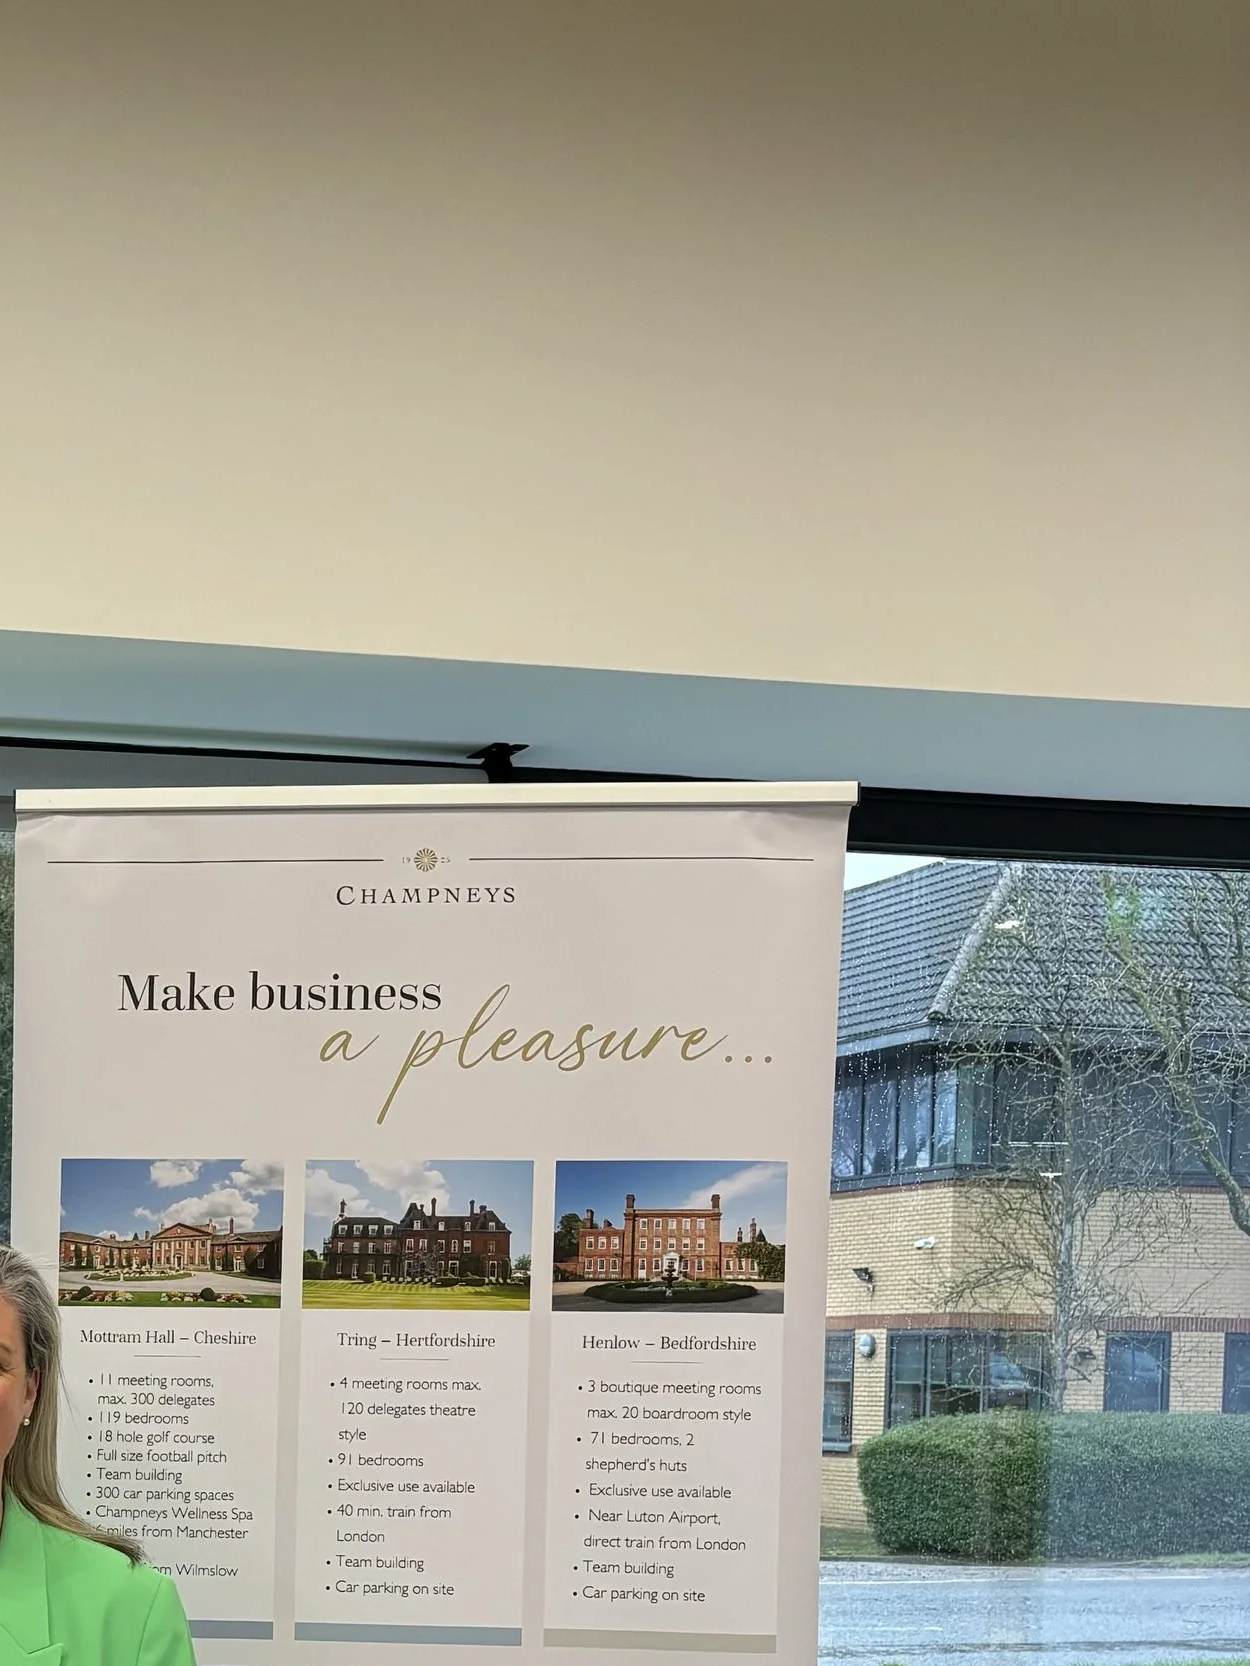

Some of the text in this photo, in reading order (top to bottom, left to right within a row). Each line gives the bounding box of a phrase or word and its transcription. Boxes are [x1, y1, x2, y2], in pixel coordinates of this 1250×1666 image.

[336, 885, 516, 906] CHAMPNEYS
[117, 970, 442, 1012] Make business
[318, 1029, 380, 1062] a
[80, 1329, 257, 1345] Mottram Hall Cheshire
[336, 1332, 496, 1350] Tring Hertfordshire
[582, 1334, 757, 1351] Henlow Bedfordshire
[100, 1372, 112, 1386] 11
[117, 1373, 168, 1390] meeting
[339, 1376, 348, 1390] 4
[351, 1376, 404, 1394] meeting
[406, 1380, 448, 1391] rooms
[587, 1379, 762, 1398] 3 boutique meeting rooms
[130, 1392, 155, 1406] 300
[157, 1393, 216, 1410] delegates
[341, 1401, 476, 1419] 120 delegates theatre
[100, 1410, 190, 1425] 119 bedrooms
[621, 1405, 639, 1419] 20
[642, 1406, 719, 1421] boardroom
[722, 1408, 752, 1424] style
[99, 1429, 216, 1447] 18 hole golf course
[338, 1427, 367, 1444] style
[590, 1431, 605, 1445] 71
[686, 1432, 695, 1446] 2
[96, 1448, 227, 1466] Full size football pitch
[585, 1457, 688, 1474] shepherd's huts
[96, 1466, 183, 1485] Team building
[95, 1485, 235, 1504] 300 car parking spaces
[337, 1478, 476, 1494] Exclusive use available
[95, 1504, 254, 1524] Champneys Wellness Spa
[588, 1508, 623, 1522] Near
[626, 1509, 665, 1523] Luton
[141, 1524, 173, 1538] from
[176, 1525, 250, 1540] Manchester
[583, 1534, 746, 1551] direct train from London
[175, 1563, 239, 1577] Wilmslow
[335, 1579, 455, 1598] Car parking on site
